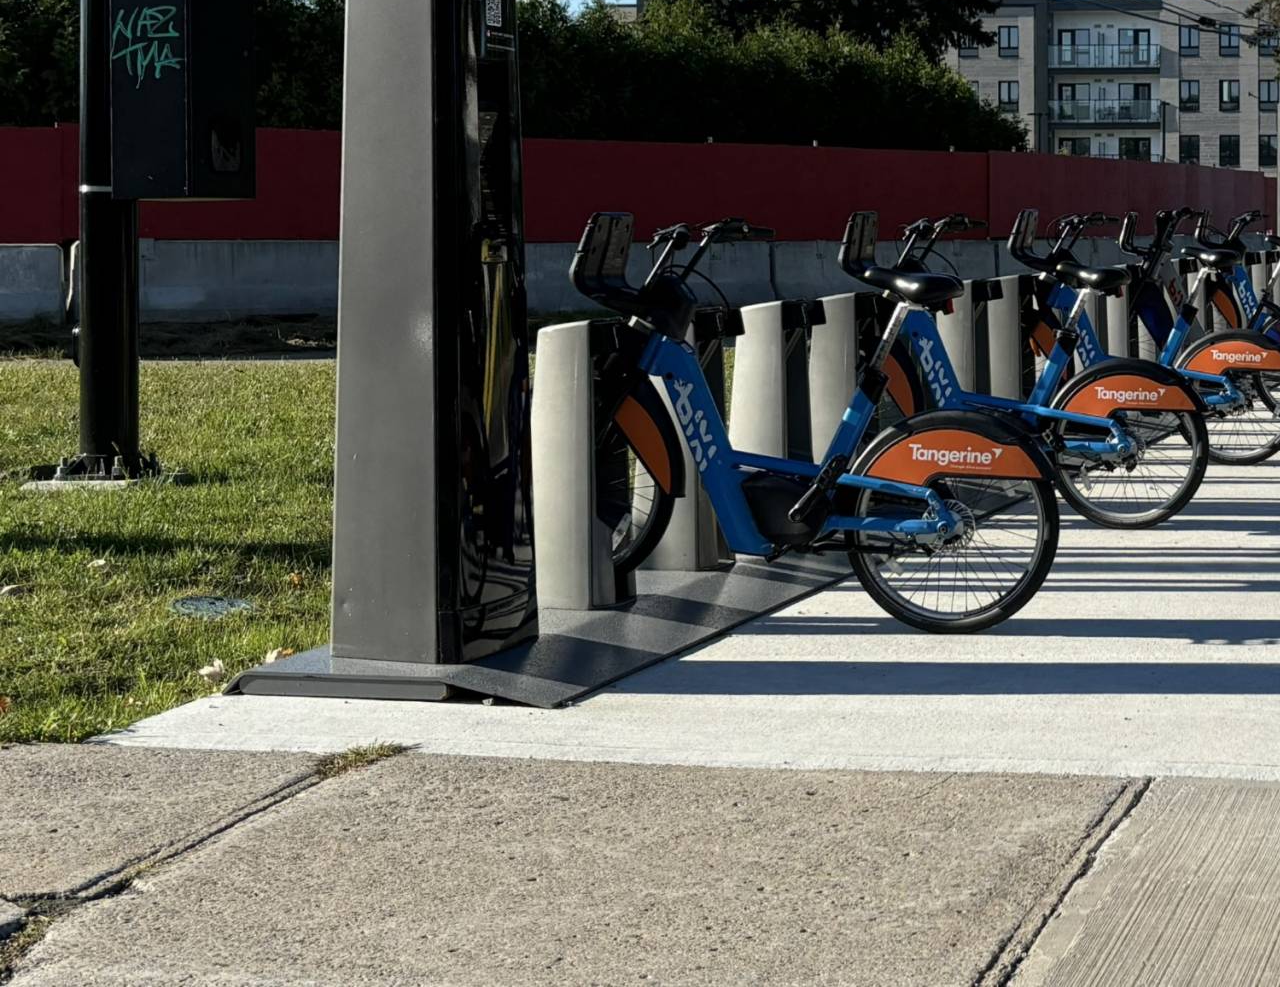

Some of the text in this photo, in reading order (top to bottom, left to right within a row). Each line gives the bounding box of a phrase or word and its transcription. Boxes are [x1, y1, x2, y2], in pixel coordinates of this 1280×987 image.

[1210, 349, 1262, 363] Tangerine
[1094, 386, 1158, 403] Tangerine
[908, 443, 992, 466] Tangerine
